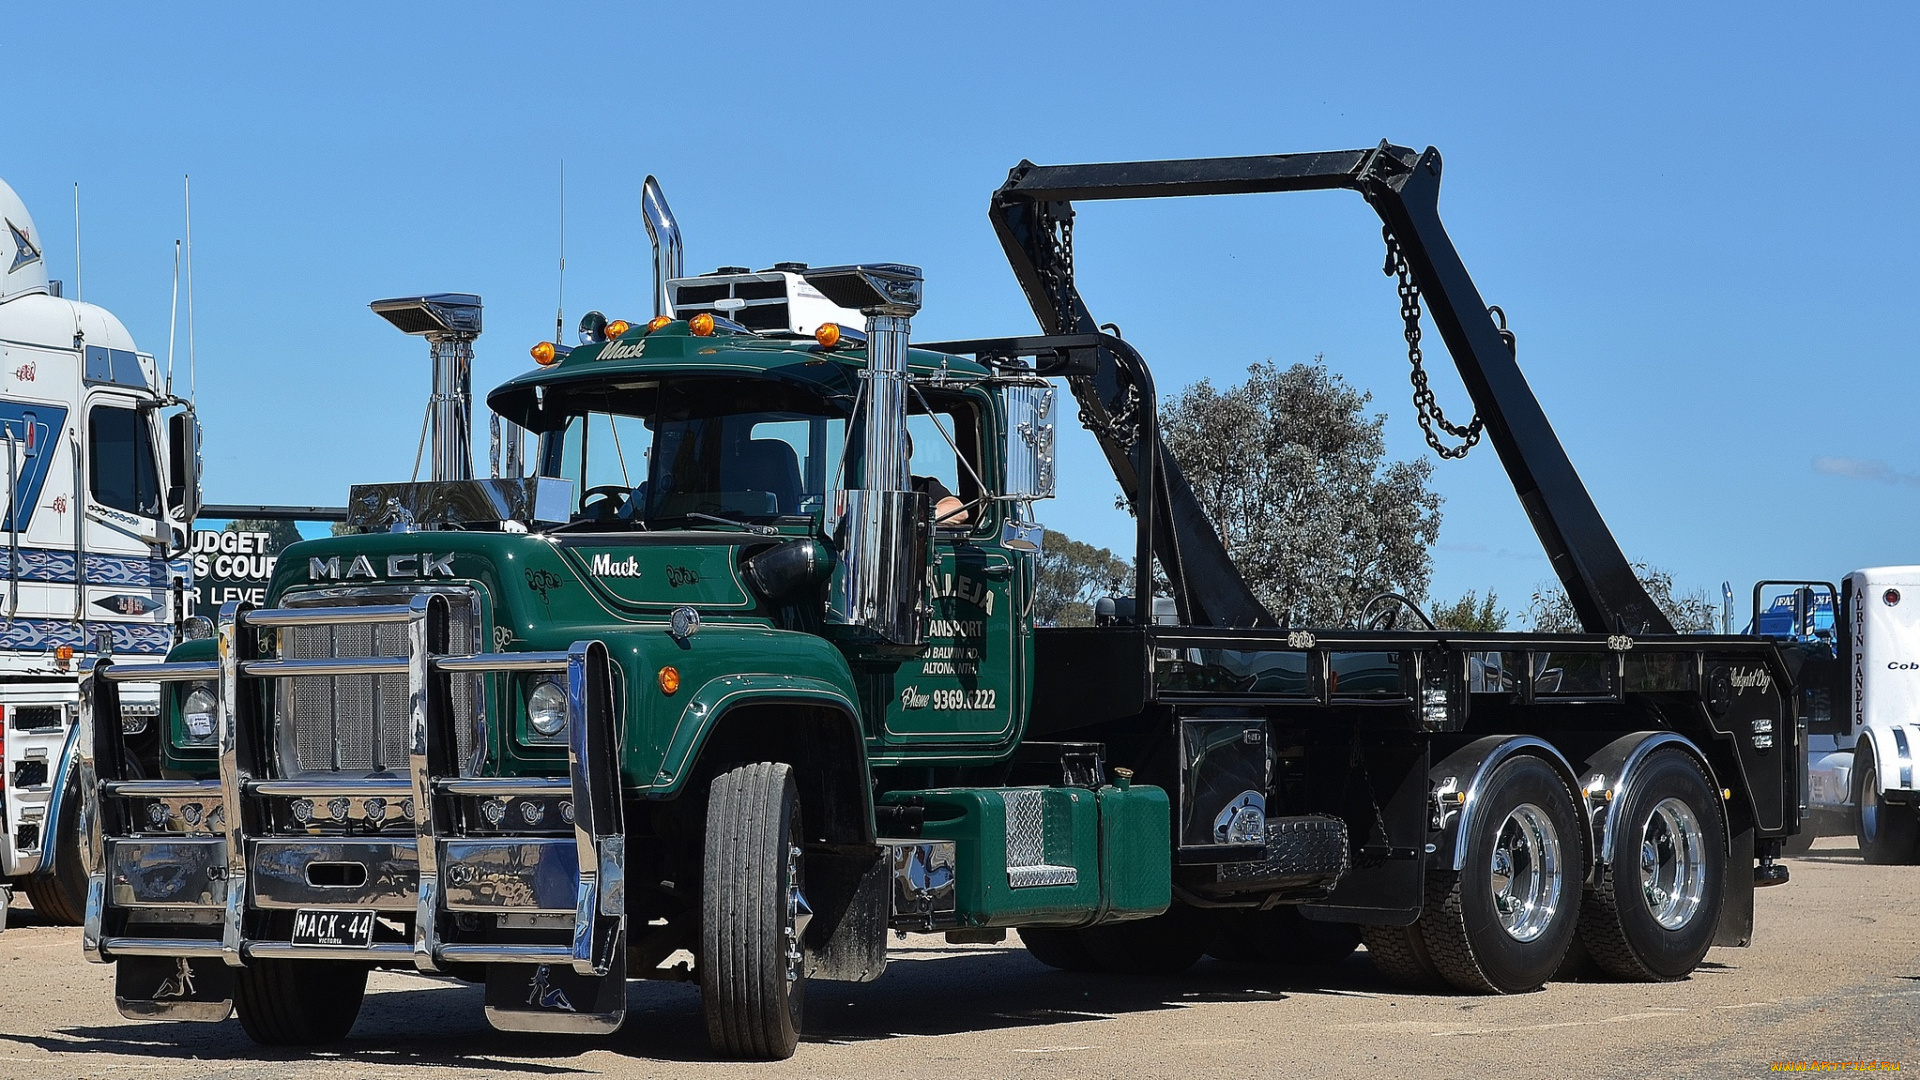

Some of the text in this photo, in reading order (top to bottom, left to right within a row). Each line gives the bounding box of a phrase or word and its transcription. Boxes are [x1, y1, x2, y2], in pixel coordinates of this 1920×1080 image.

[596, 339, 646, 361] Mack
[191, 531, 269, 554] UDGET
[309, 551, 455, 581] MACK
[591, 553, 642, 577] Mack
[1855, 587, 1864, 725] ALRIN PANELS
[922, 662, 956, 675] ALTONA
[901, 685, 930, 712] Phone
